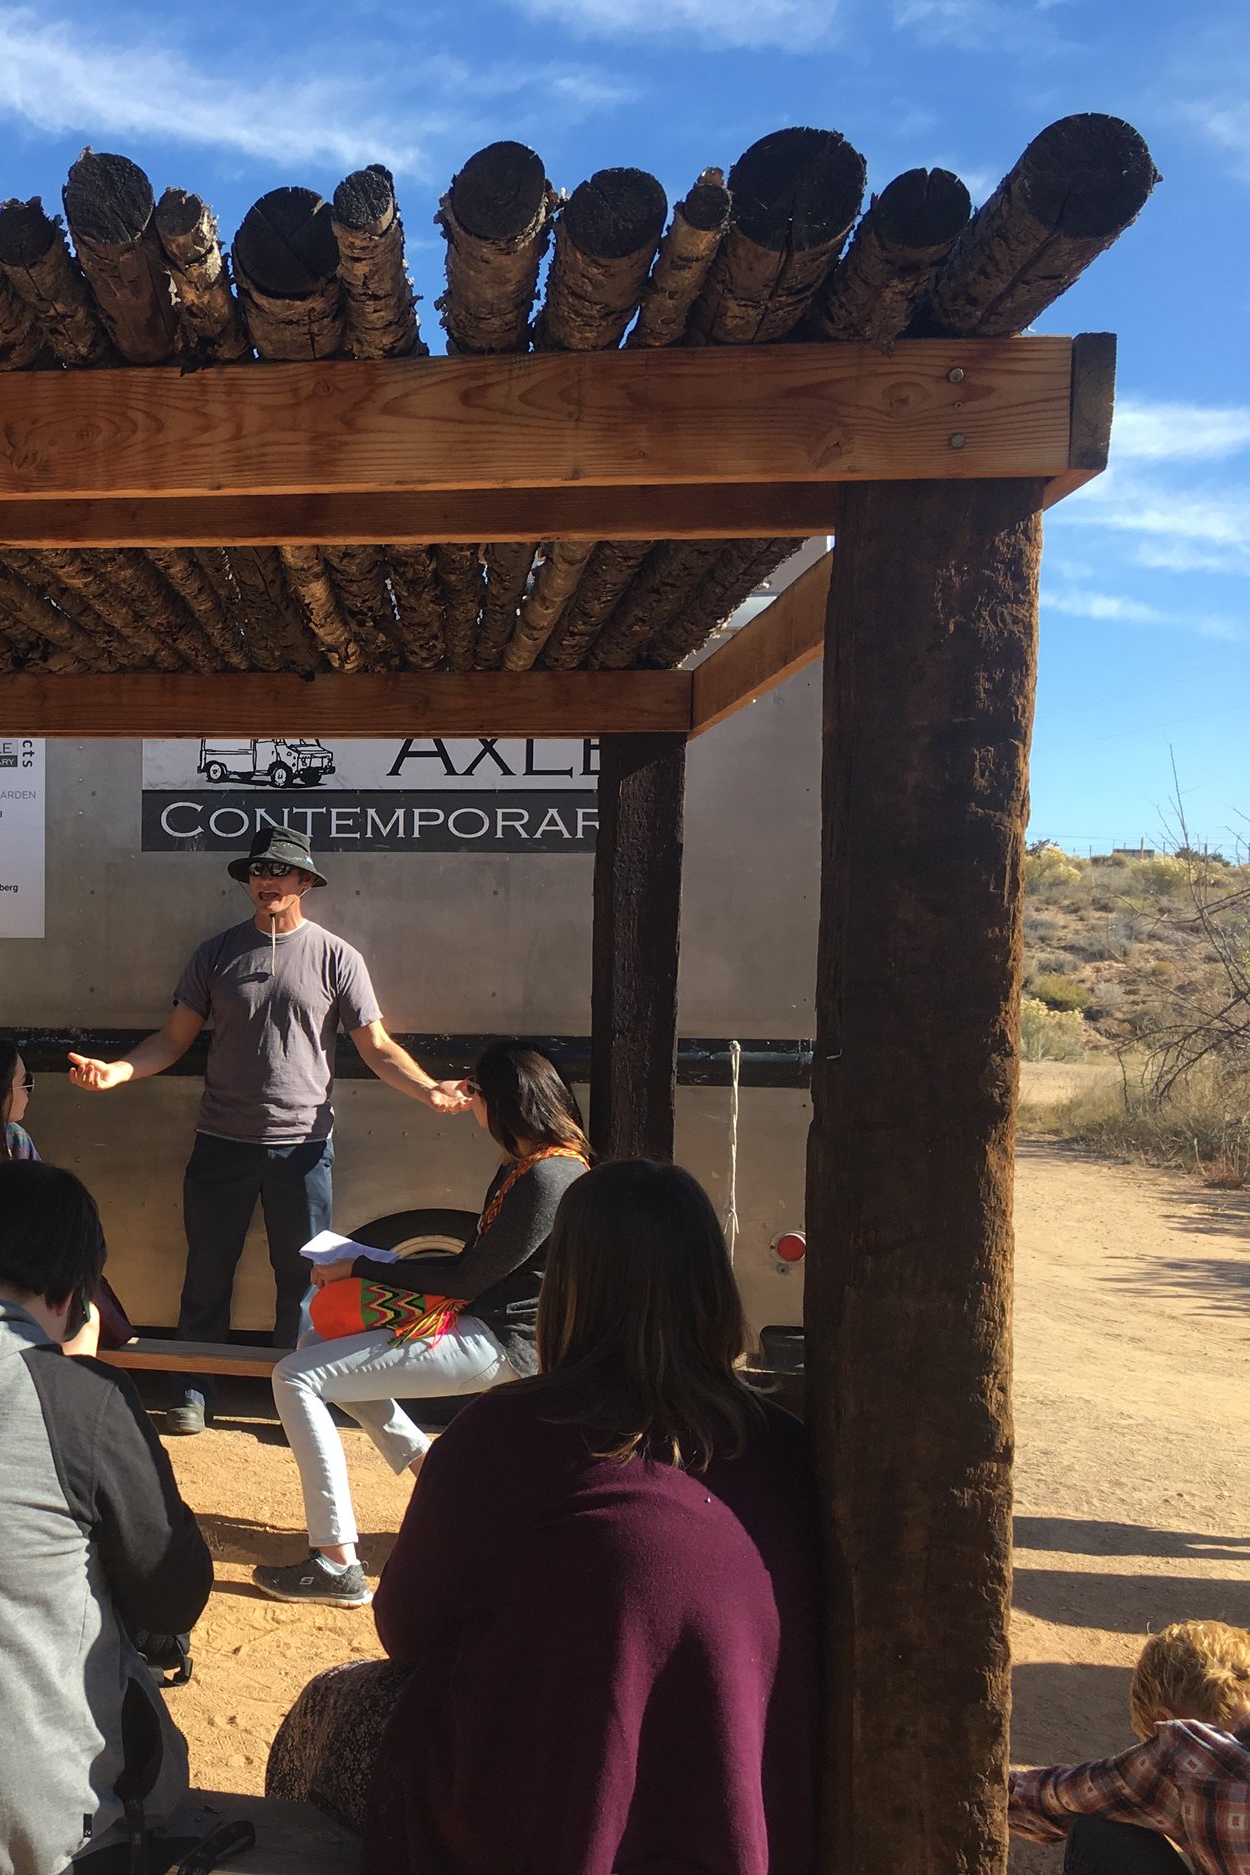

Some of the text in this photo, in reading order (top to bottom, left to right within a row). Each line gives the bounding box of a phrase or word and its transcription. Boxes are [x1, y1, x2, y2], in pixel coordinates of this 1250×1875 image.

[22, 739, 35, 768] cts
[388, 738, 600, 778] AXL
[160, 801, 600, 840] CONTEMPORAR
